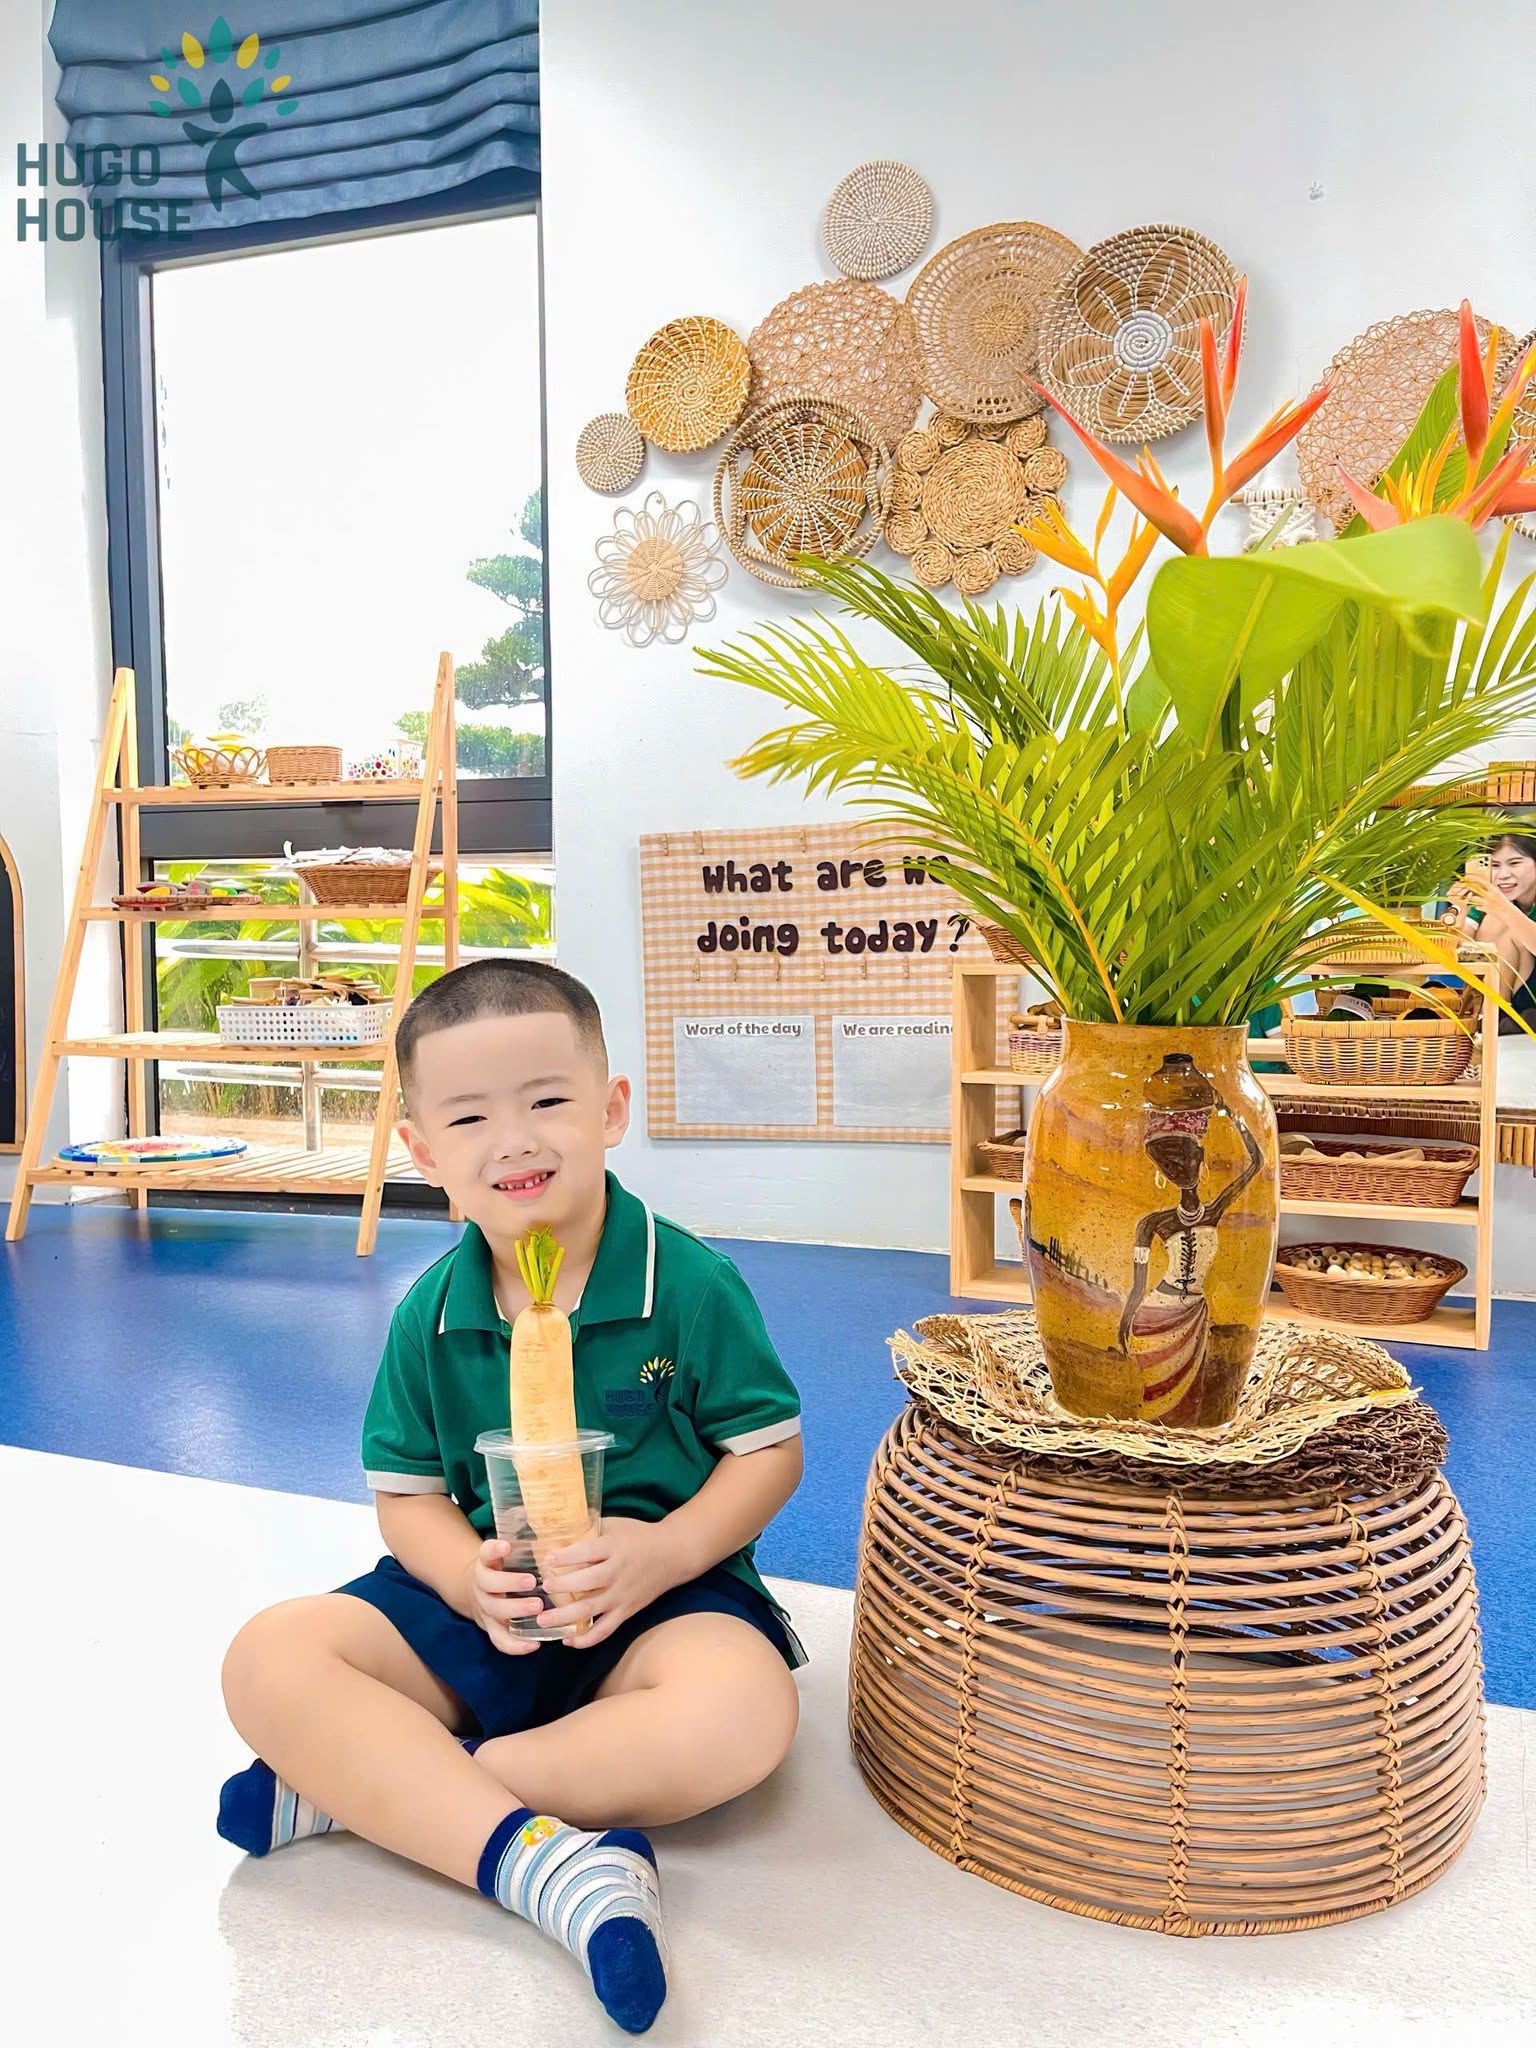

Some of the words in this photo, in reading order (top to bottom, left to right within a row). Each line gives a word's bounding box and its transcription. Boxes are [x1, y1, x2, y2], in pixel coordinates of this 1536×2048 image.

[816, 859, 887, 888] are
[697, 915, 800, 956] doing
[686, 1024, 724, 1036] Word
[727, 1022, 742, 1035] of
[745, 1023, 769, 1035] the
[772, 1022, 802, 1037] day
[843, 1024, 866, 1036] We
[868, 1026, 894, 1036] are
[897, 1021, 953, 1035] readin
